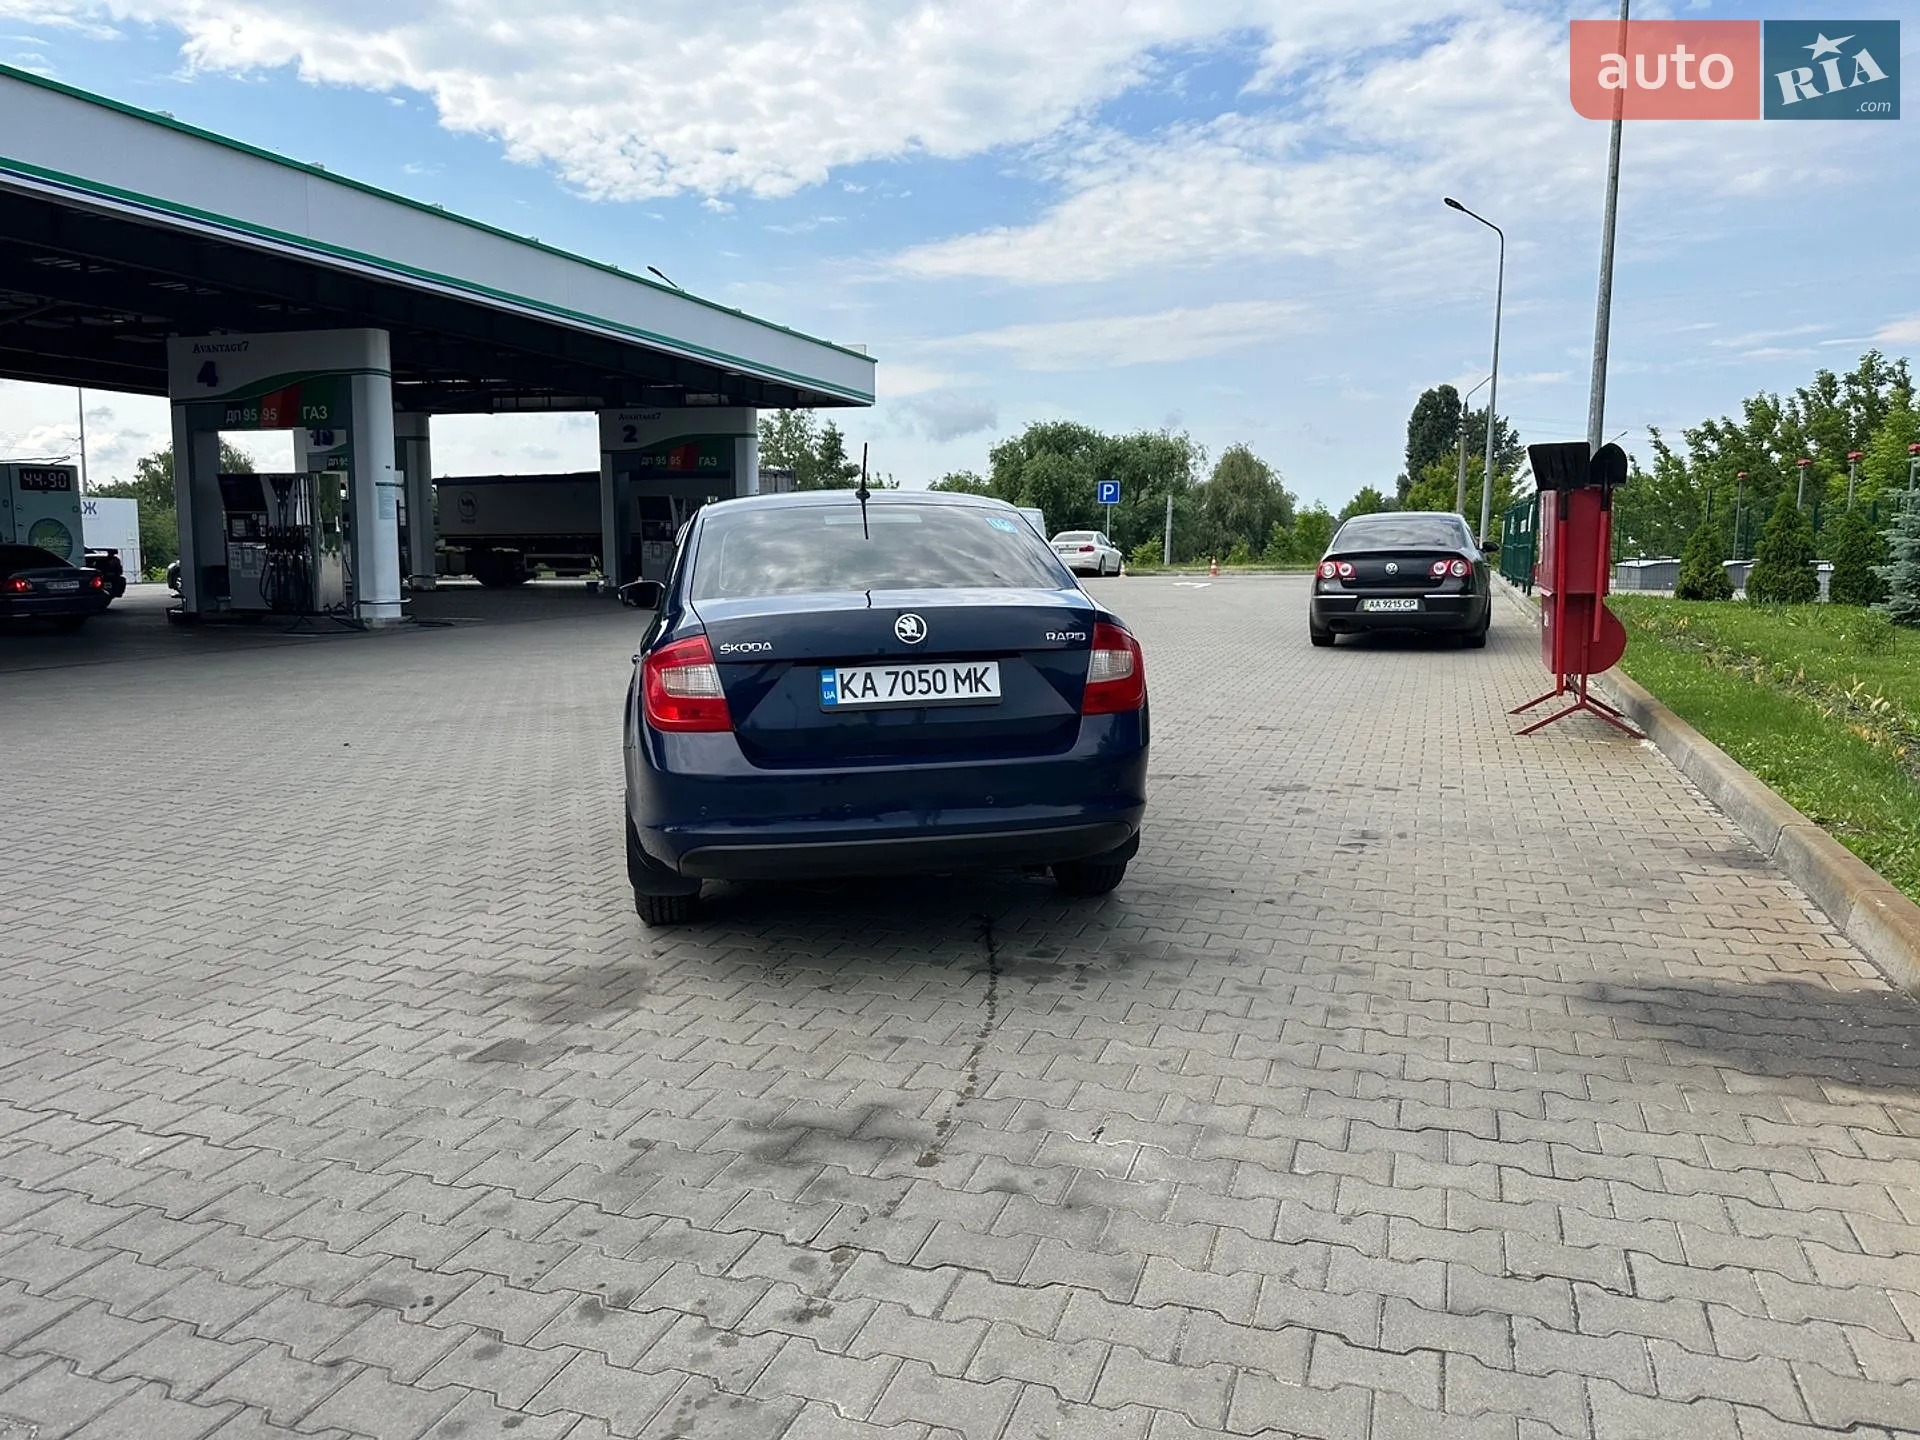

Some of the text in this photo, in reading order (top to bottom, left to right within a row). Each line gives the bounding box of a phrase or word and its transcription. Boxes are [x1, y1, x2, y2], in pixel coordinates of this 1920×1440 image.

[197, 360, 219, 387] 4
[226, 405, 328, 424] ДП 95 95 ГАЗ
[622, 425, 638, 443] 2
[698, 456, 717, 466] ГАЗ
[1102, 483, 1115, 500] P
[839, 666, 992, 699] KA 7050 MK
[823, 691, 836, 700] UA
